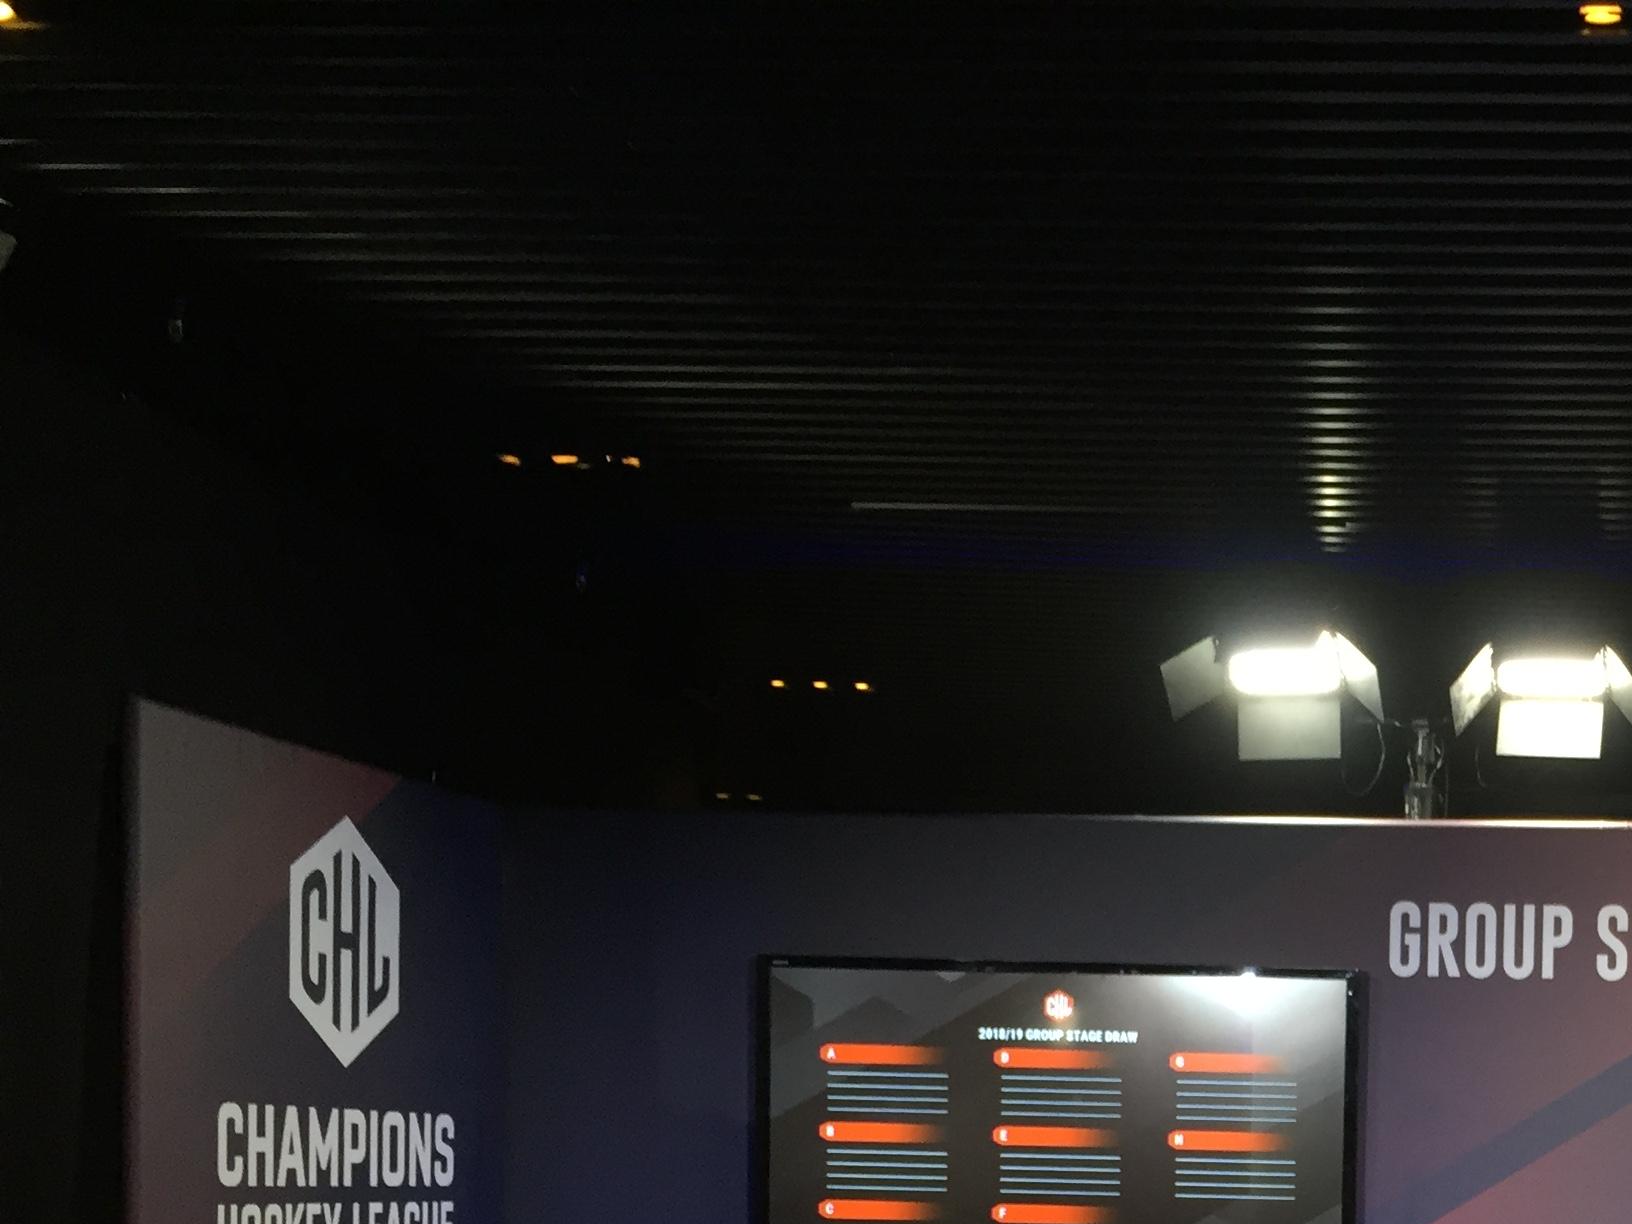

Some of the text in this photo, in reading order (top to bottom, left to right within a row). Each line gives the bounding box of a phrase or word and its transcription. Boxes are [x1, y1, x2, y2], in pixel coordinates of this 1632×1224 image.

[299, 848, 392, 1032] CHL
[1389, 900, 1573, 981] GROUP
[826, 1047, 836, 1060] A
[978, 1026, 1139, 1044] 2018/19 GROUP STAGE DRAW
[216, 1101, 456, 1188] CHAMPIONS
